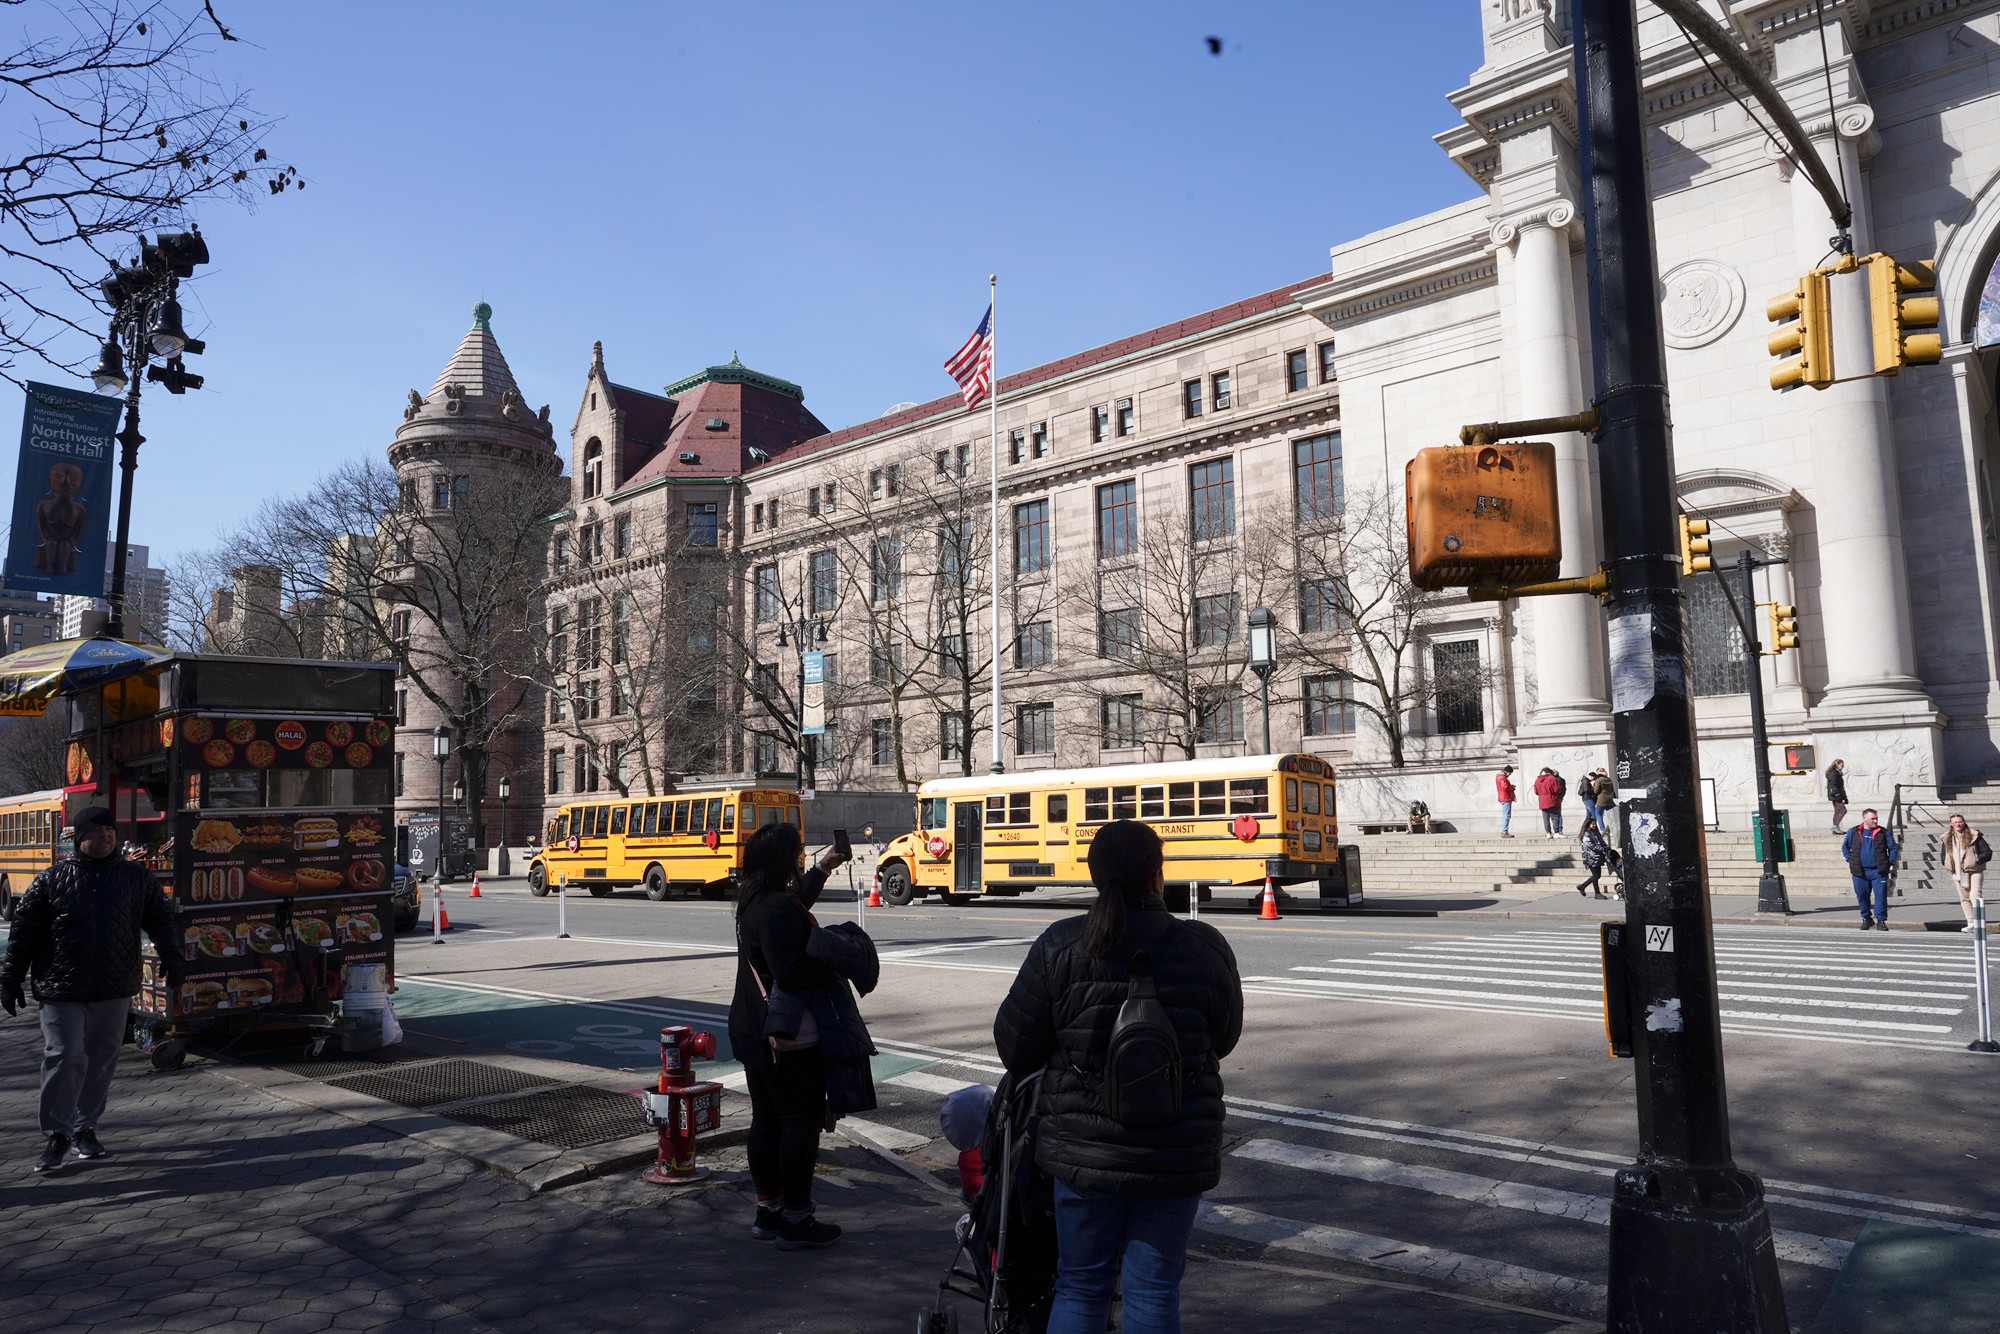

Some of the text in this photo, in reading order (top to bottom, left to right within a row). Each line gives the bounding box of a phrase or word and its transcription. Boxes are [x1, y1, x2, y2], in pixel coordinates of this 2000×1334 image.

[34, 407, 75, 421] Introducing
[46, 416, 62, 427] fully
[63, 420, 99, 432] revitalized
[31, 423, 110, 447] Northwest
[30, 436, 104, 458] Coast Hall
[278, 731, 303, 740] HALAL
[753, 793, 789, 803] SCHOOL BUS
[1160, 824, 1196, 834] TRANSIT
[1003, 832, 1021, 841] 12640
[930, 841, 944, 852] STOP
[344, 951, 387, 961] ITALIAN SAUSAGE
[185, 971, 226, 981] CHEESEBURGER
